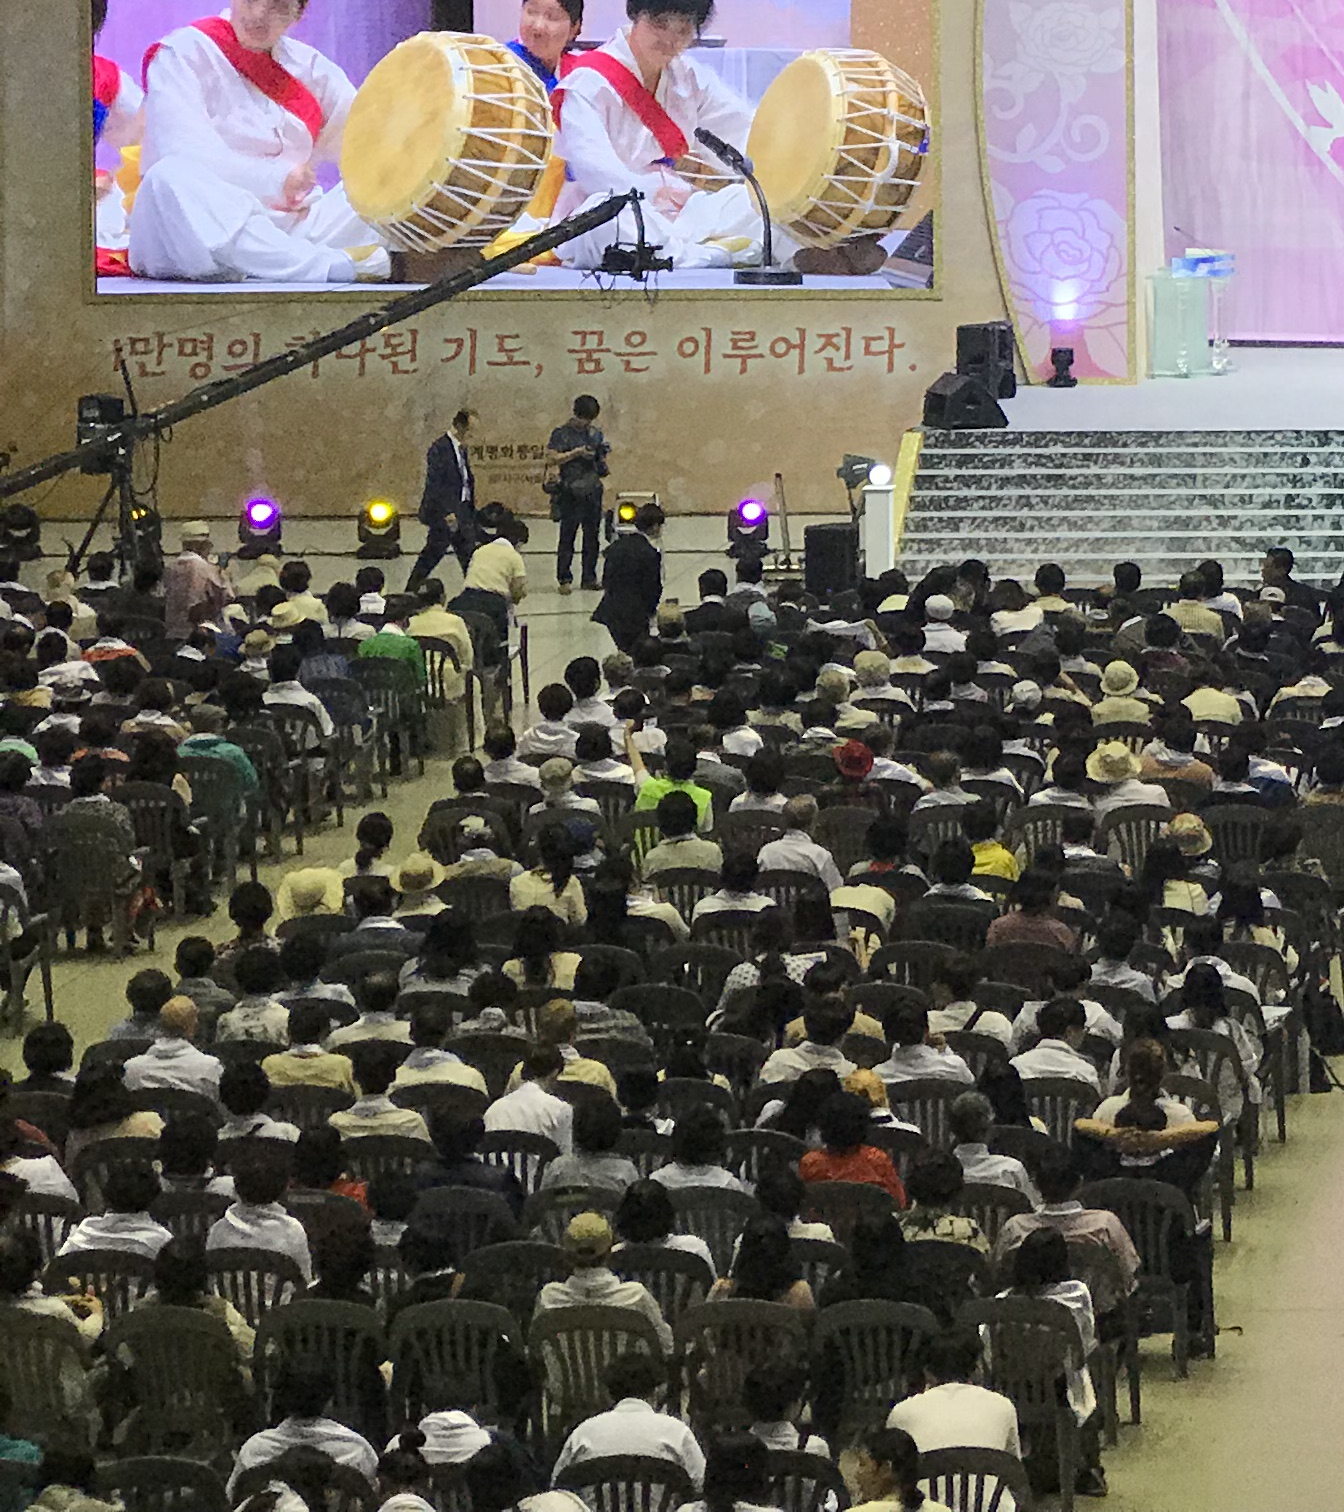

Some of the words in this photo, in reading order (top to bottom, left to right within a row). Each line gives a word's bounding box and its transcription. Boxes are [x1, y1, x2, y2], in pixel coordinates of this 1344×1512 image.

[440, 327, 543, 378] 기도,
[566, 330, 658, 375] 꿈은
[676, 326, 917, 376] 이루어진다.
